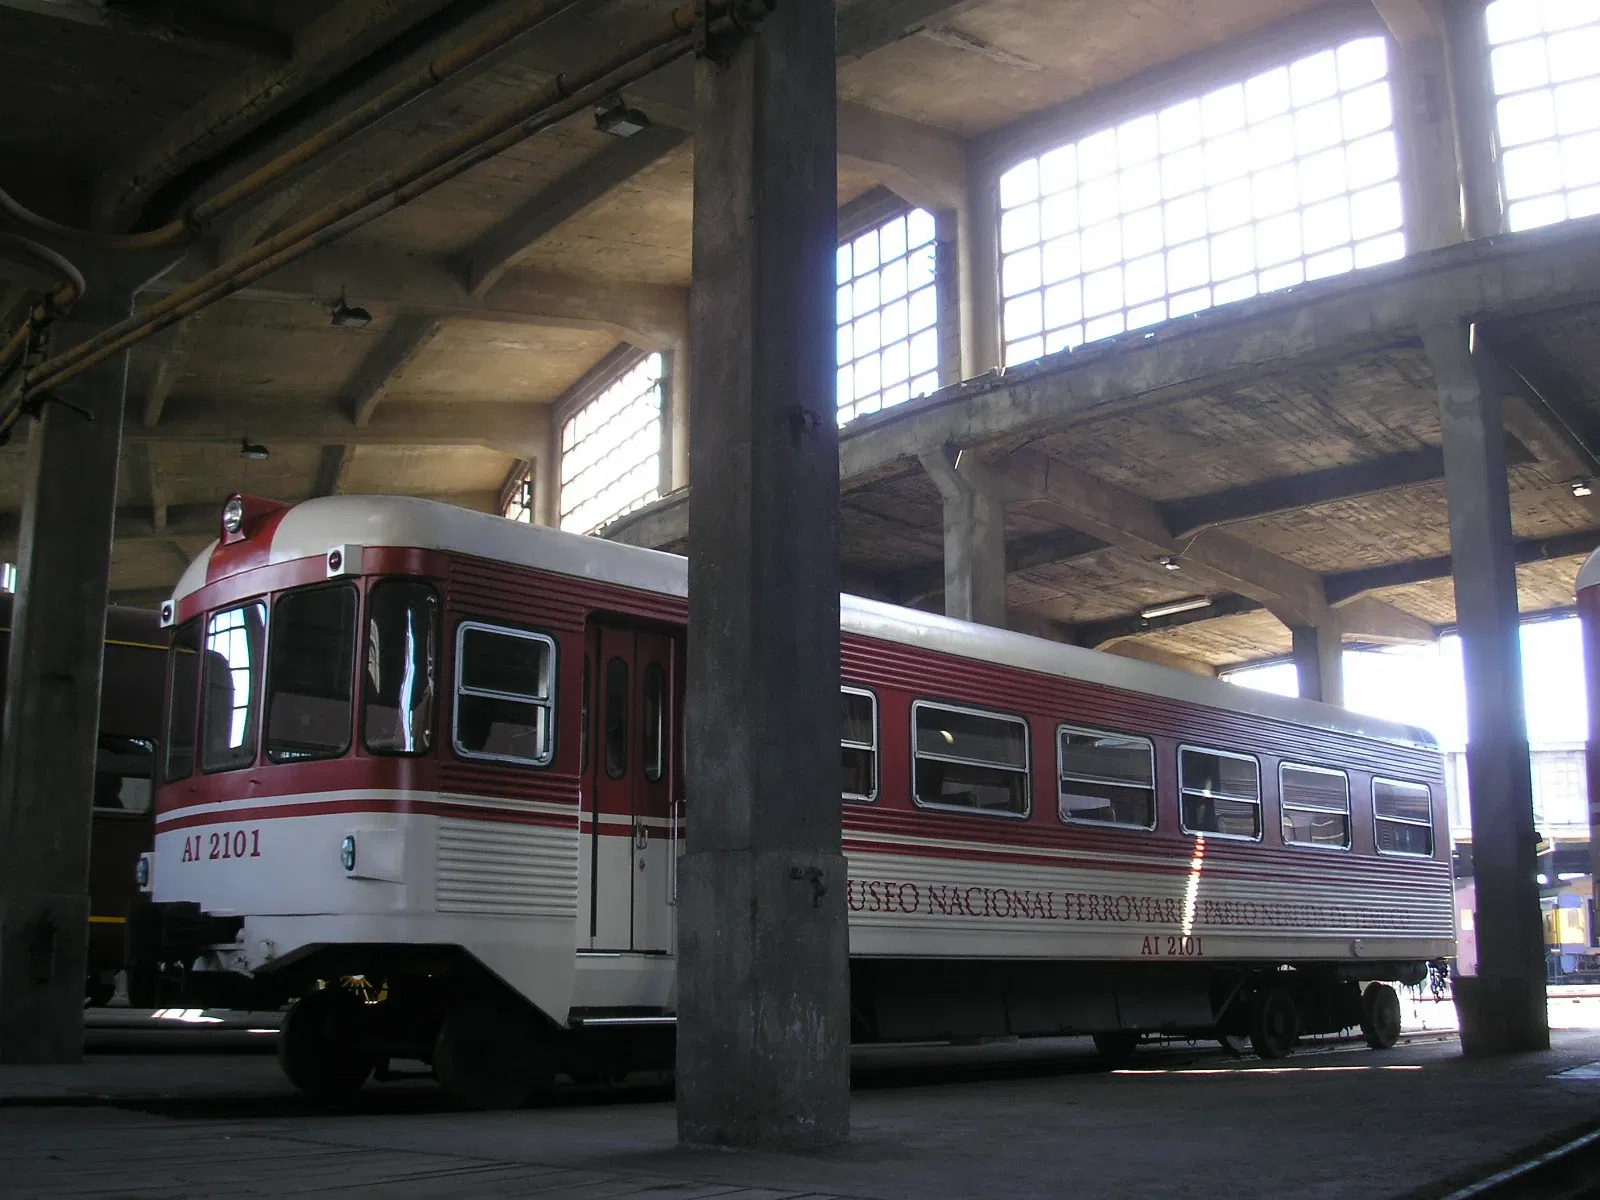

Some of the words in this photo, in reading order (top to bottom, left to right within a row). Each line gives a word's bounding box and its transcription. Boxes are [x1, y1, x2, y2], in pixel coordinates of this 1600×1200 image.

[182, 835, 202, 863] AI
[209, 829, 261, 860] 2101
[847, 879, 920, 914] USEO
[927, 883, 1059, 920] NACIONAL
[1203, 899, 1257, 925] PABLO
[1141, 935, 1160, 955] AI
[1167, 935, 1203, 956] 2101
